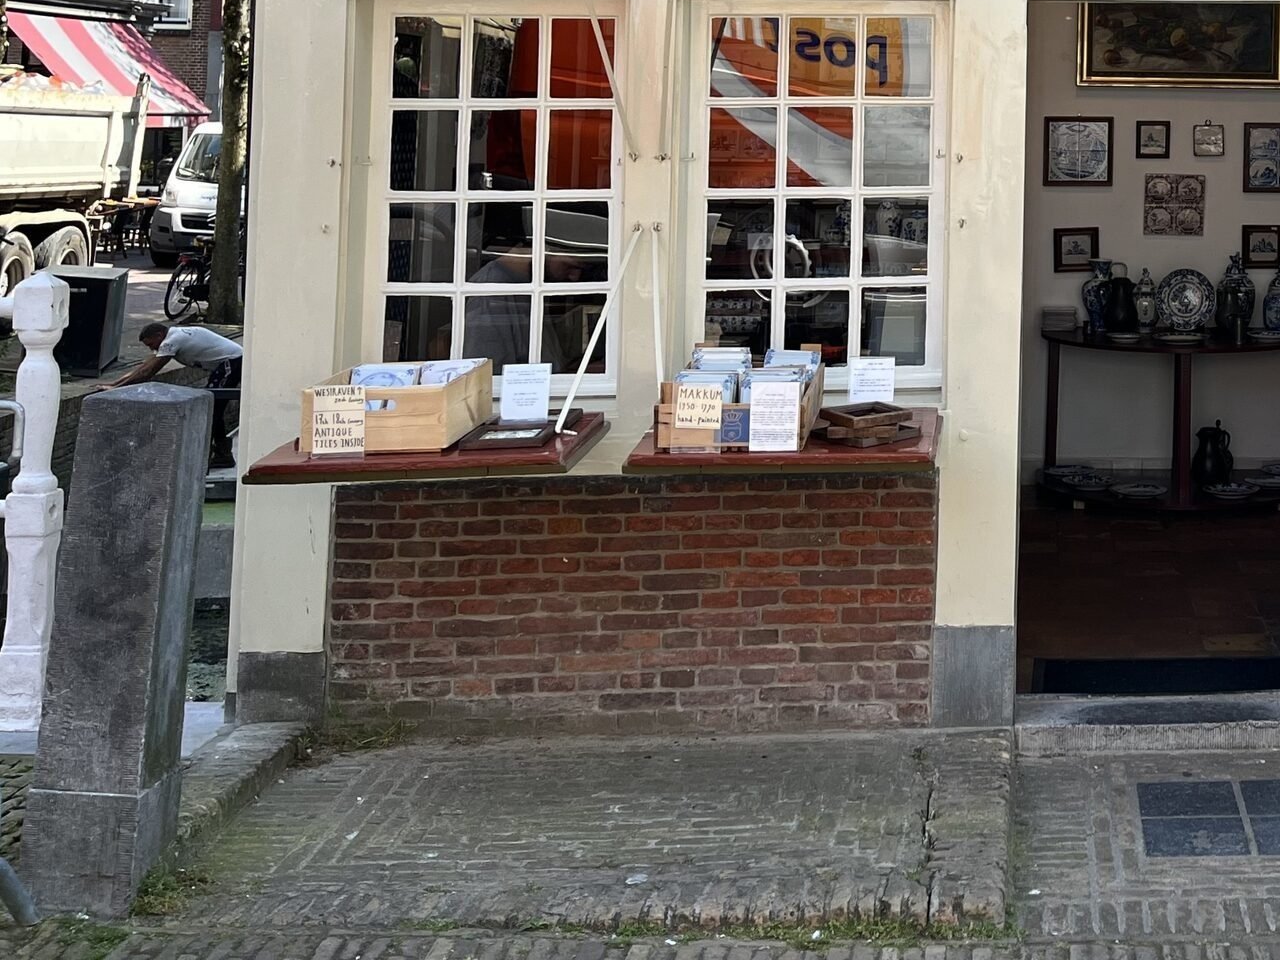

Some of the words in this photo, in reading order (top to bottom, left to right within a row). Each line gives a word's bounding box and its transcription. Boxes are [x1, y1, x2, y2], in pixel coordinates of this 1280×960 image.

[679, 388, 723, 400] MAKKUM
[314, 427, 354, 438] ANTIQUE
[314, 439, 338, 449] TILES
[340, 437, 365, 449] INSIDE
